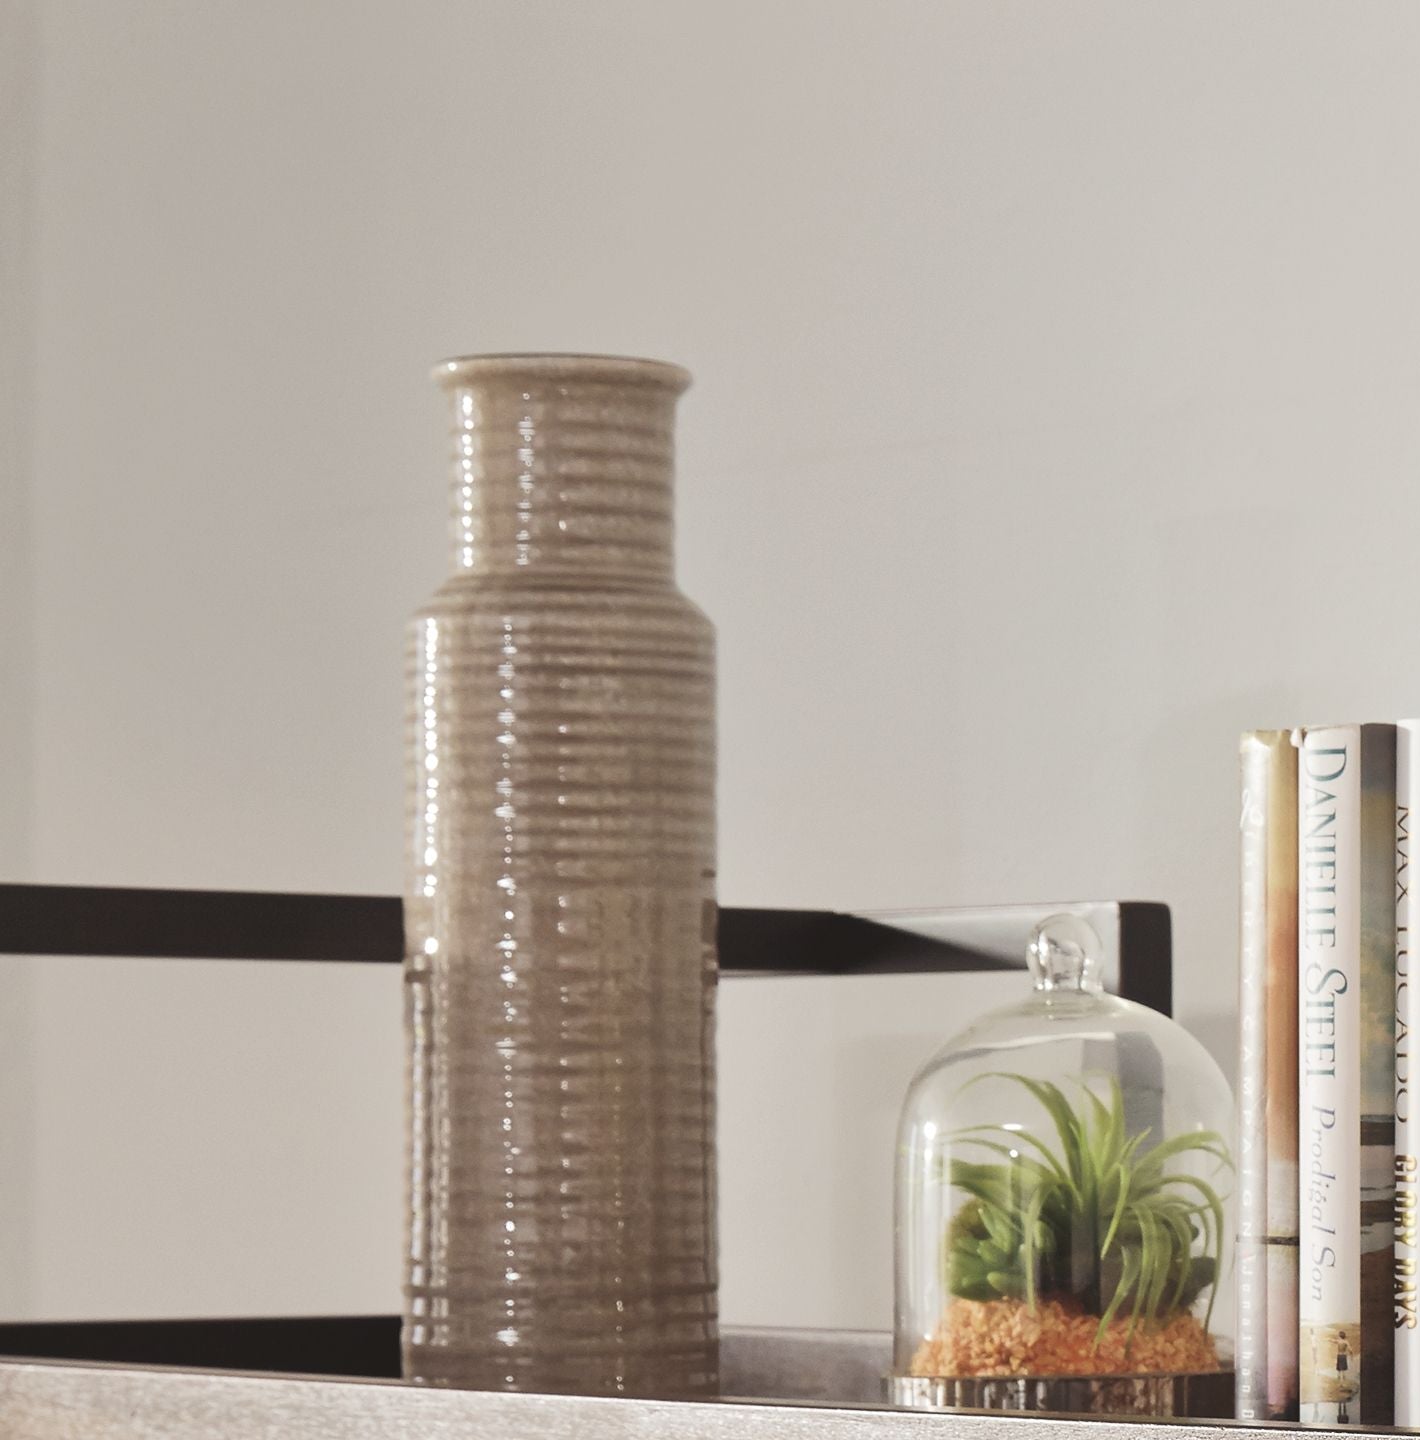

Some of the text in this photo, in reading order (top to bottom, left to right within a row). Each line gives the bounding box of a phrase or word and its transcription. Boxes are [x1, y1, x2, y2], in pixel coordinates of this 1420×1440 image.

[1242, 1014, 1253, 1237] CAMPAIGN
[1303, 745, 1348, 1302] DANIELLE STEEL Prodigal Son
